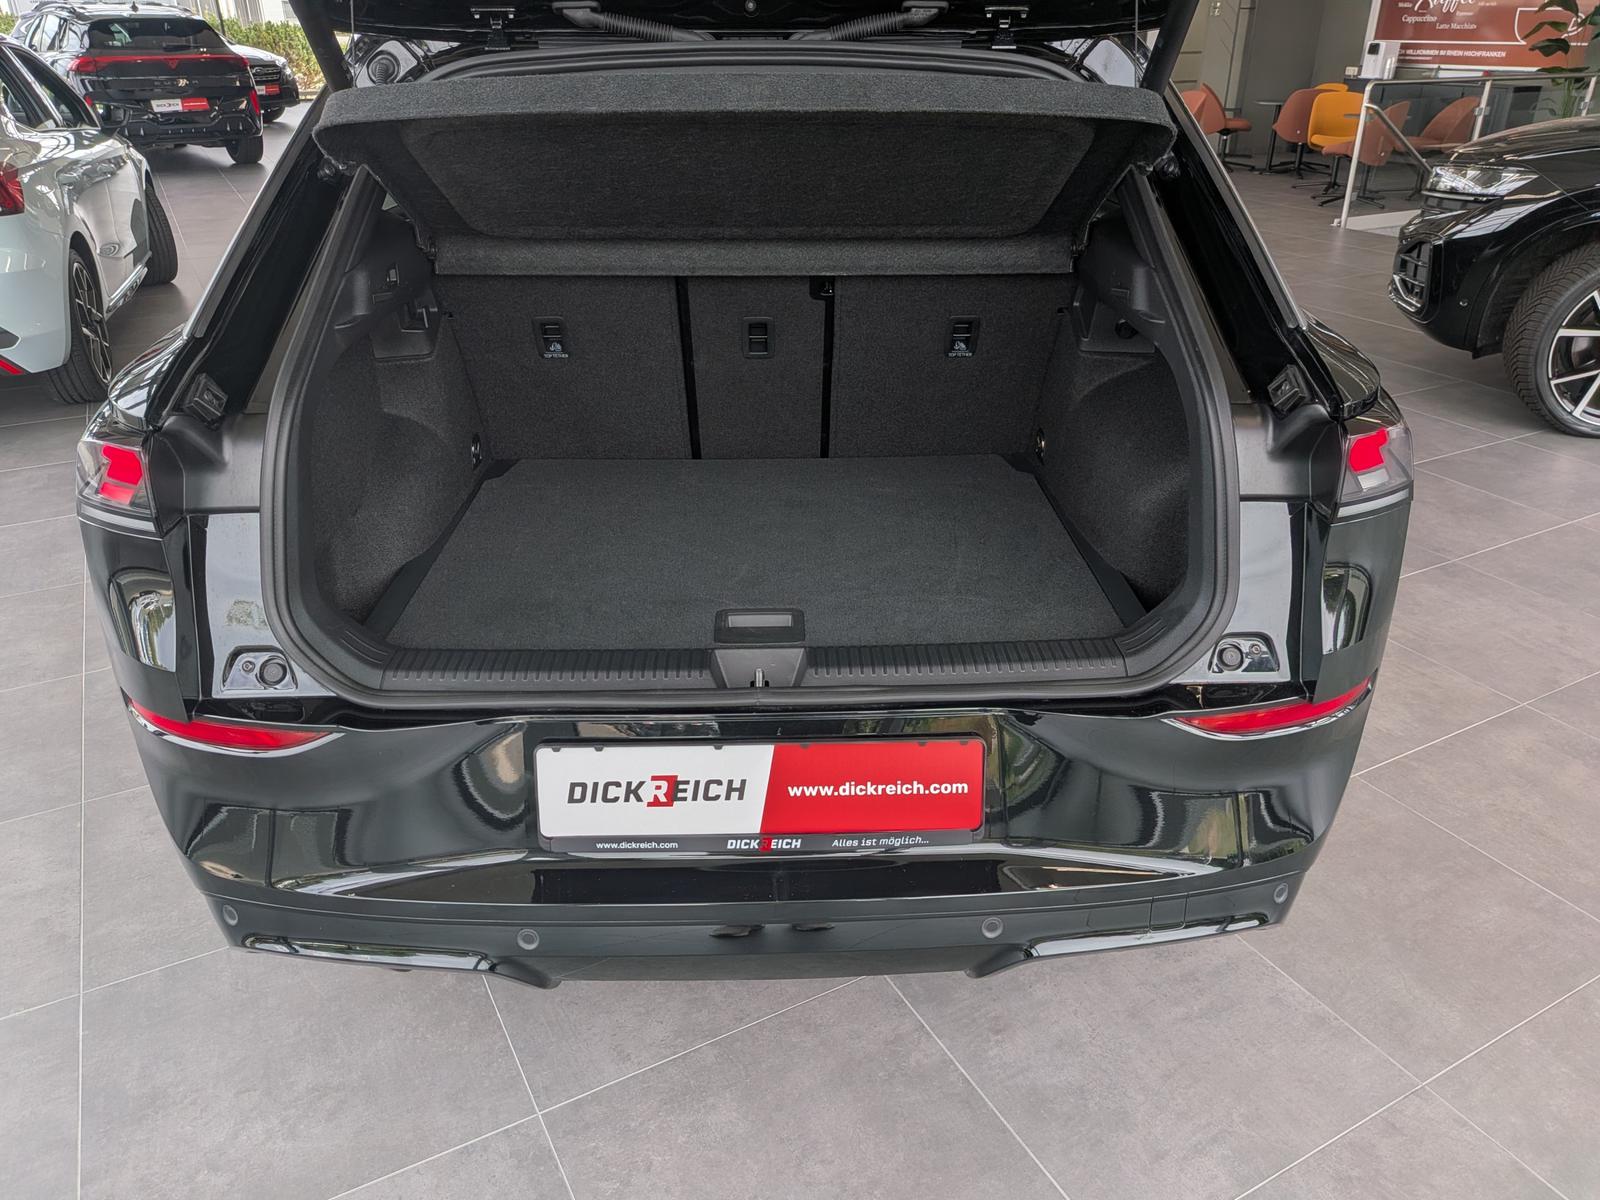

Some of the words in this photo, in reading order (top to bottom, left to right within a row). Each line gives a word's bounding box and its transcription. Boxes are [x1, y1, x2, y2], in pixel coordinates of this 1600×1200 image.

[1402, 15, 1437, 23] Cappuccino
[567, 776, 747, 807] DICKREICH
[787, 780, 968, 797] www.dickreich.com
[596, 841, 678, 849] www.dickreich.com
[727, 838, 801, 851] DICKREICH
[832, 840, 858, 848] Alles
[861, 838, 877, 847] ist
[879, 836, 929, 848] möglich...
